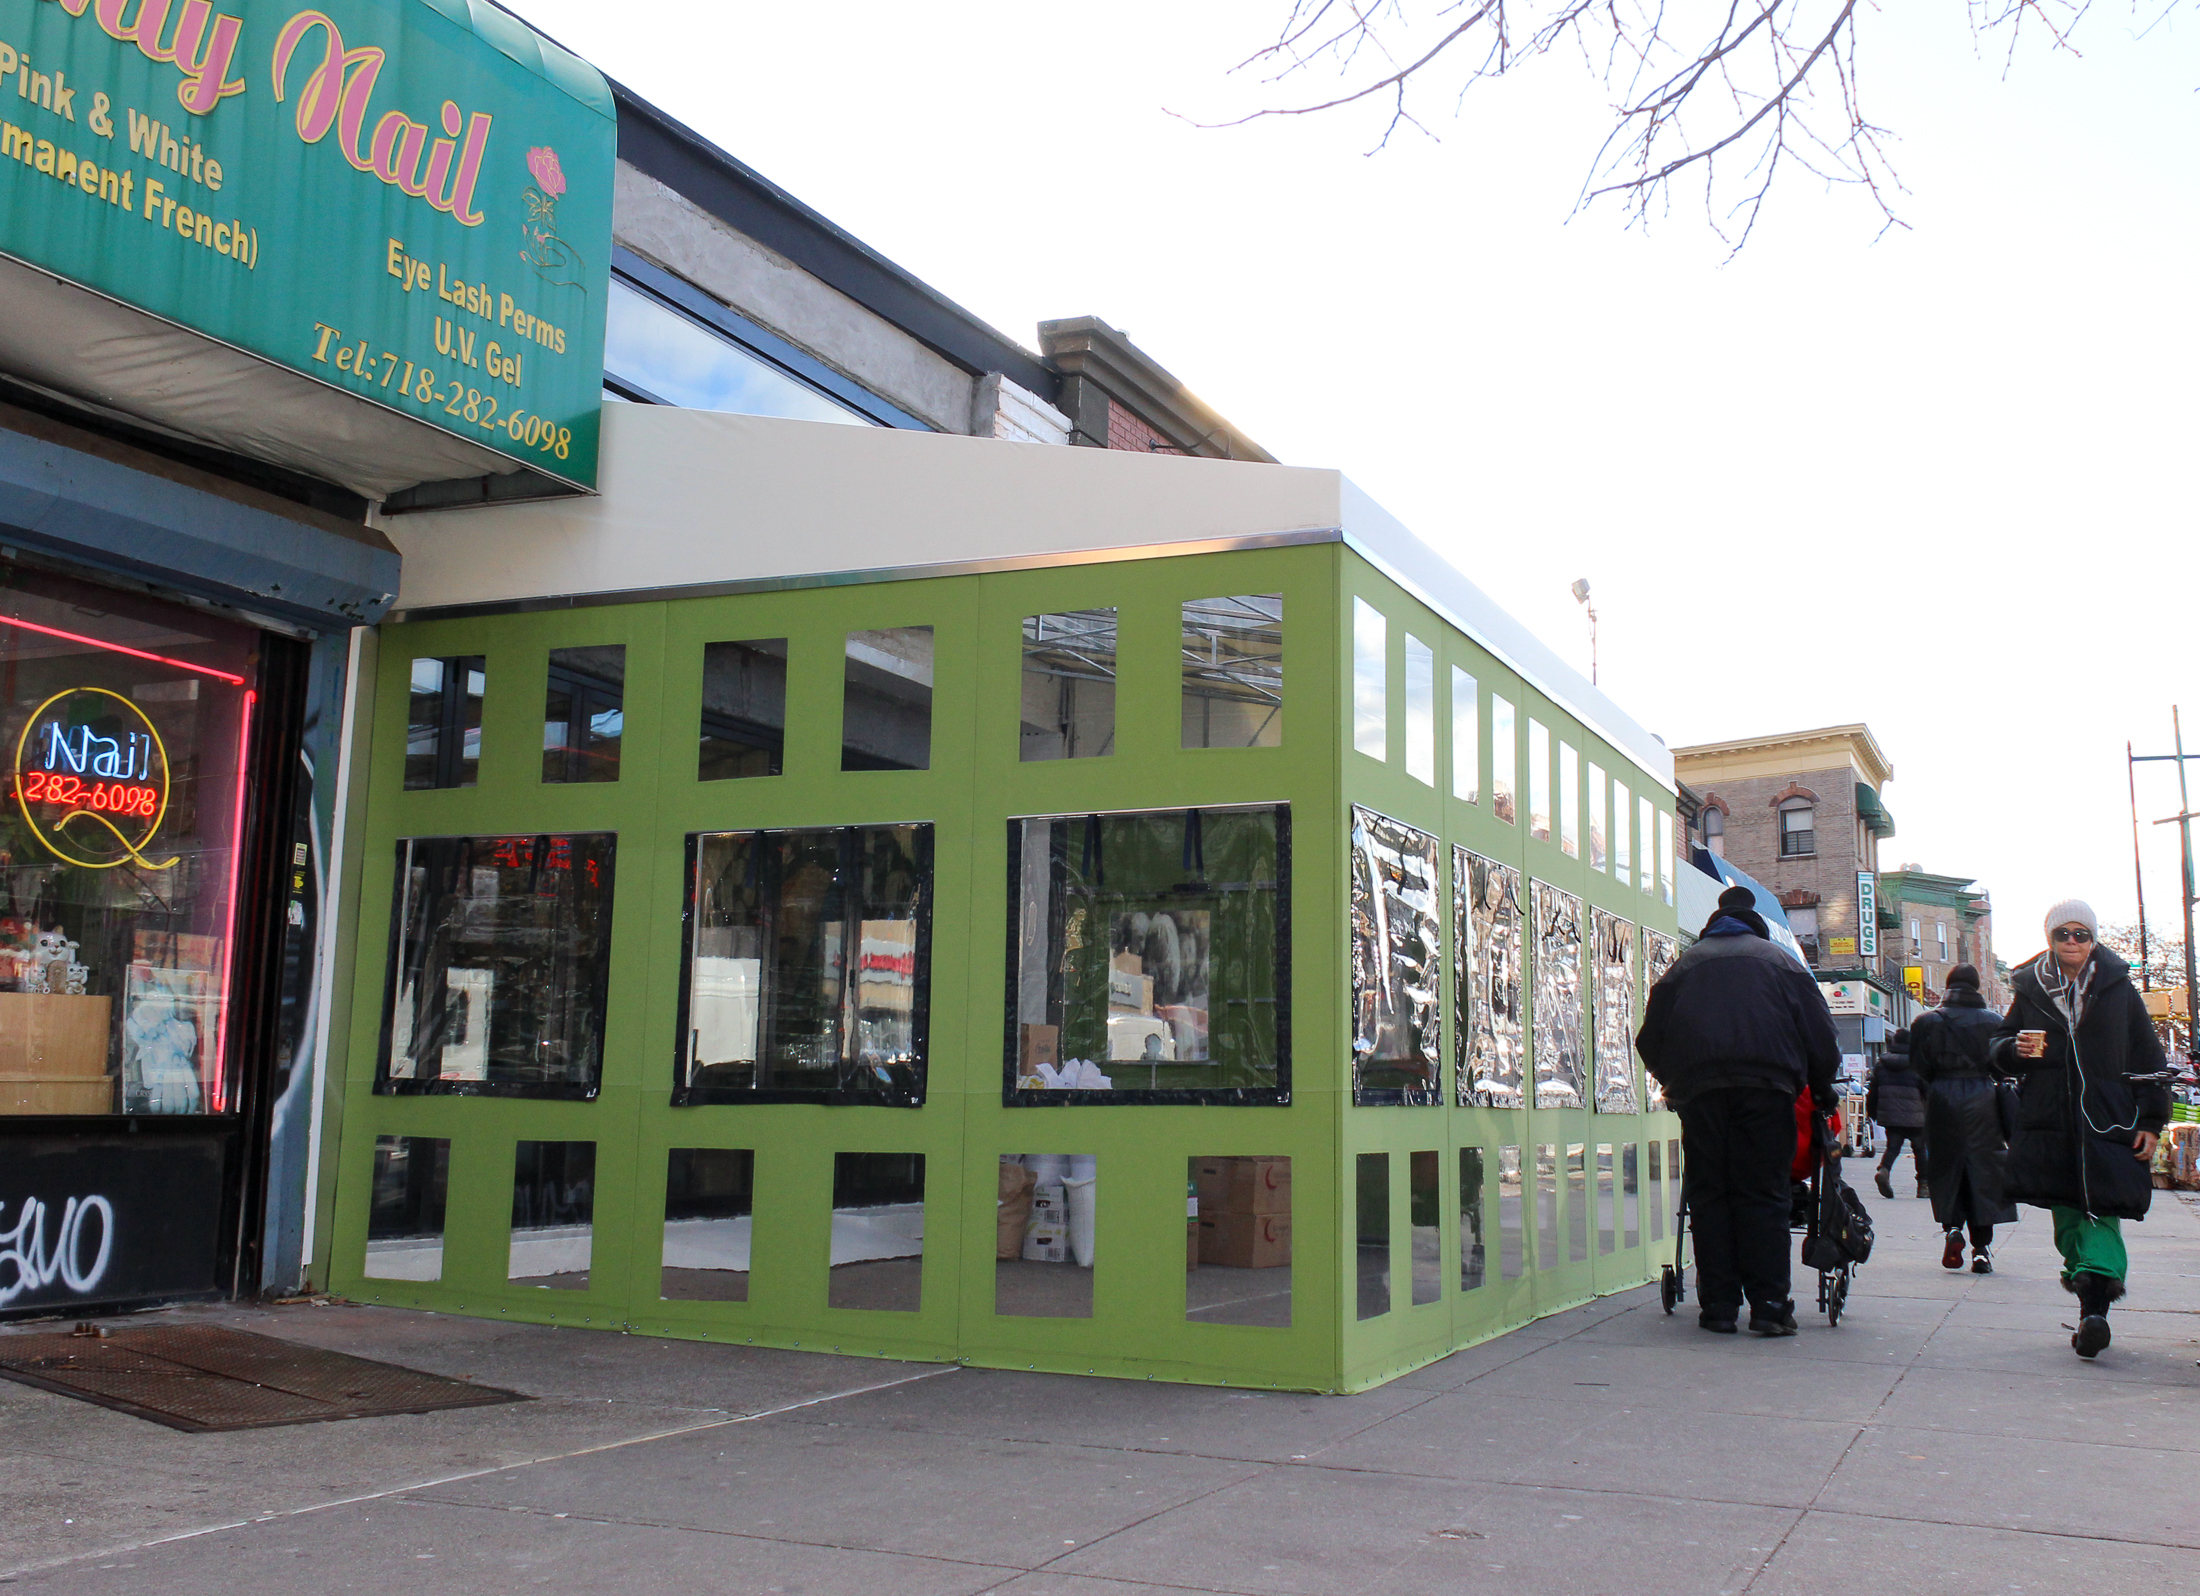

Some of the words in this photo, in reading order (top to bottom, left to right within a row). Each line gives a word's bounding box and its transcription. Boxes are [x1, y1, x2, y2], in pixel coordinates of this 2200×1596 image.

[0, 41, 77, 122] Pink
[88, 91, 115, 140] &
[128, 107, 223, 191] White
[272, 9, 495, 227] Nail
[0, 118, 134, 212] manent
[144, 177, 258, 270] French)
[387, 237, 432, 292] Eye
[438, 262, 493, 321] Lash
[499, 292, 567, 355] Perms
[434, 316, 478, 369] U.V.
[485, 340, 523, 388] Gel
[24, 771, 158, 817] 282-6098
[44, 721, 150, 781] Nail
[1860, 883, 1875, 952] DRUGS
